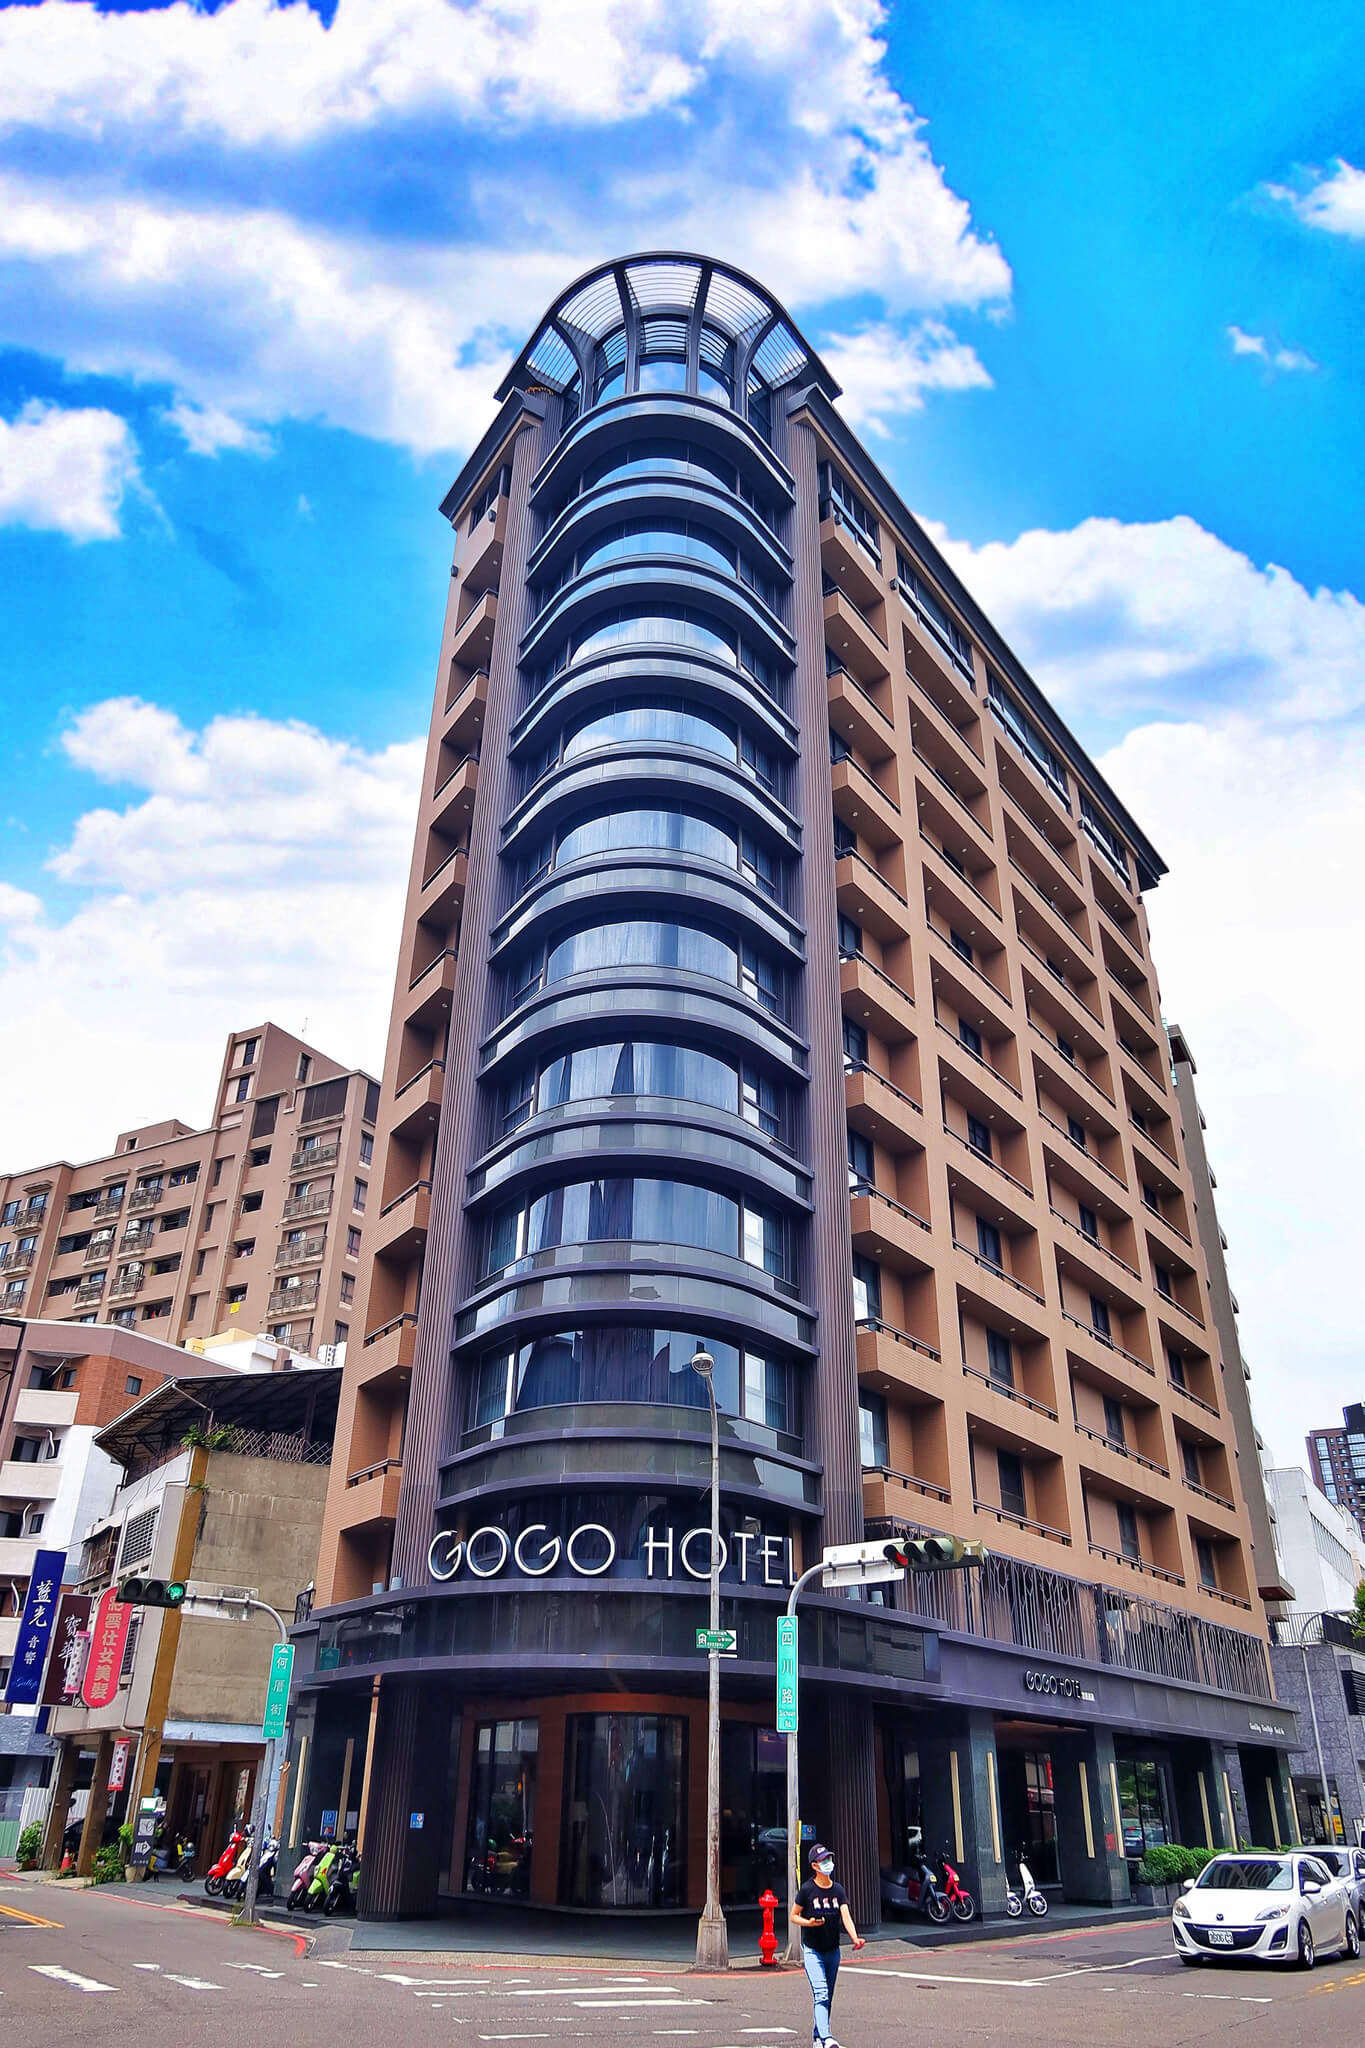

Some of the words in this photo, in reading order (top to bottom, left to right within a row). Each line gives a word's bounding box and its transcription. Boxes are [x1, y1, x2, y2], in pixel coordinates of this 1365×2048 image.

[428, 1523, 616, 1581] GOGO
[643, 1527, 800, 1587] HOTEL
[781, 1632, 793, 1705] 四川路
[1025, 1670, 1058, 1695] GOGO
